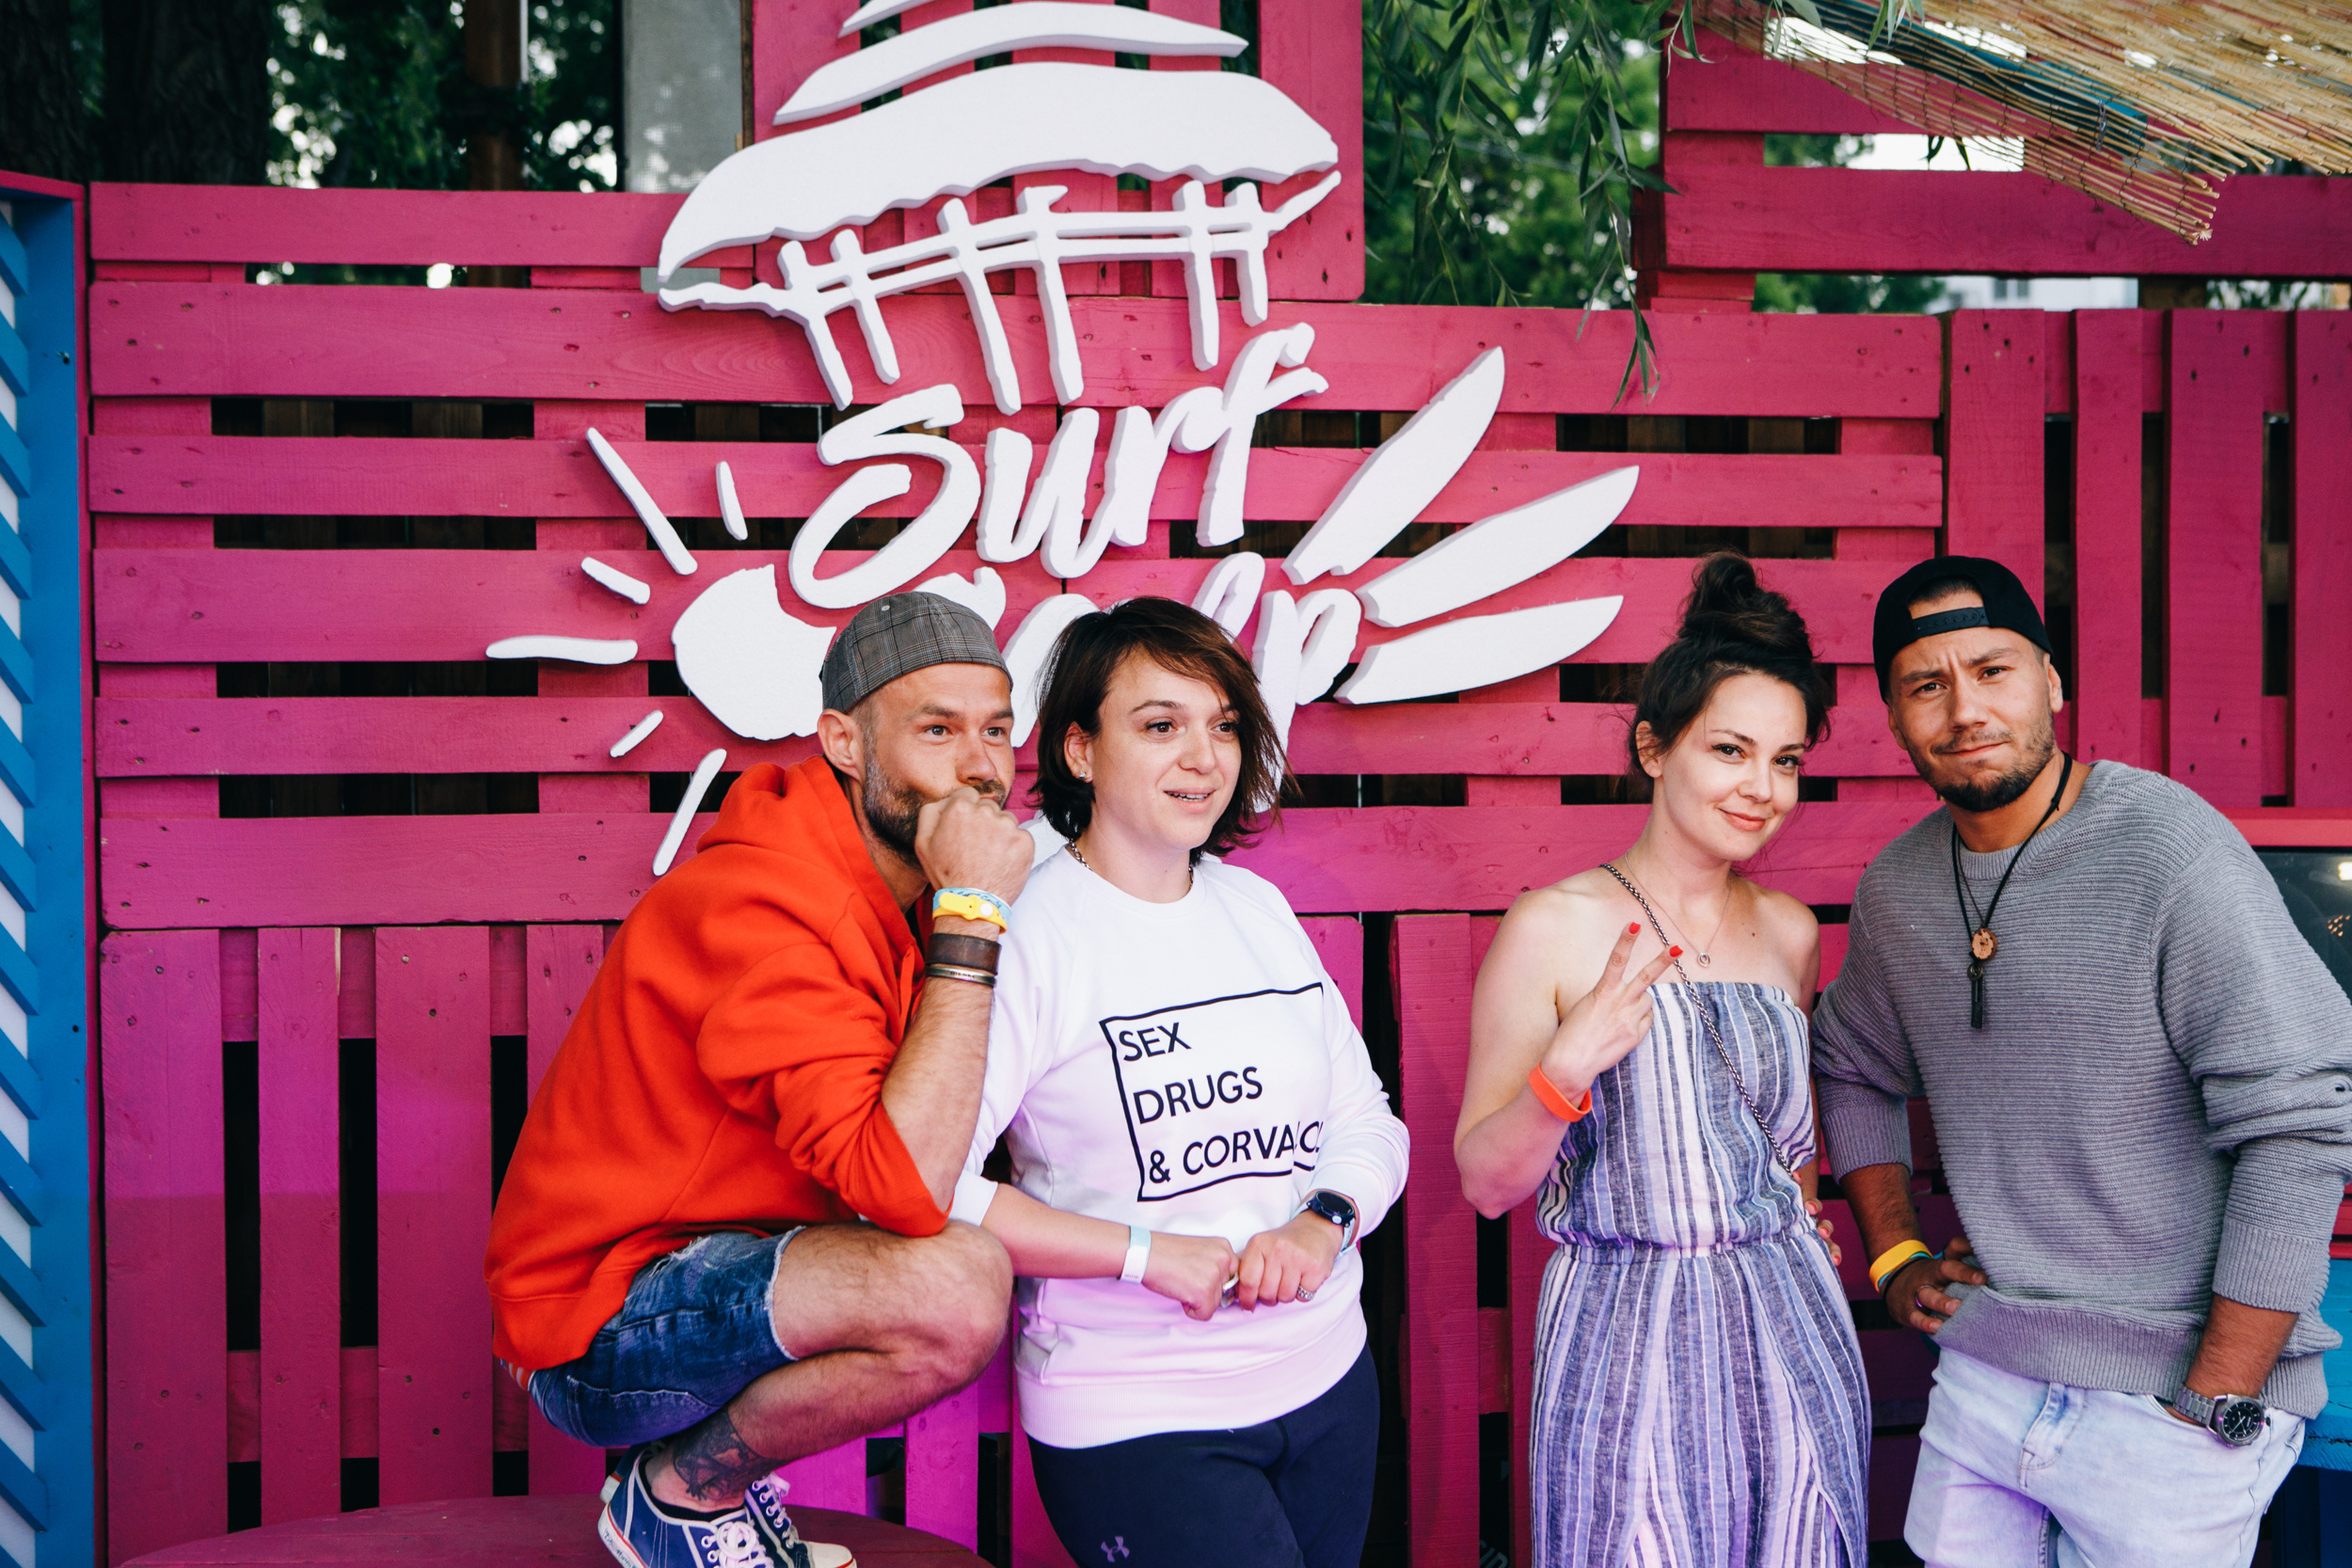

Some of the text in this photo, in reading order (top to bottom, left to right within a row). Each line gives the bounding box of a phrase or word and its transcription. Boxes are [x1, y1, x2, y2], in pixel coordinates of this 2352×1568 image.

[787, 323, 1329, 610] Surf
[1119, 1022, 1192, 1062] SEX
[1133, 1066, 1263, 1124] DRUGS
[1149, 1149, 1171, 1183] &
